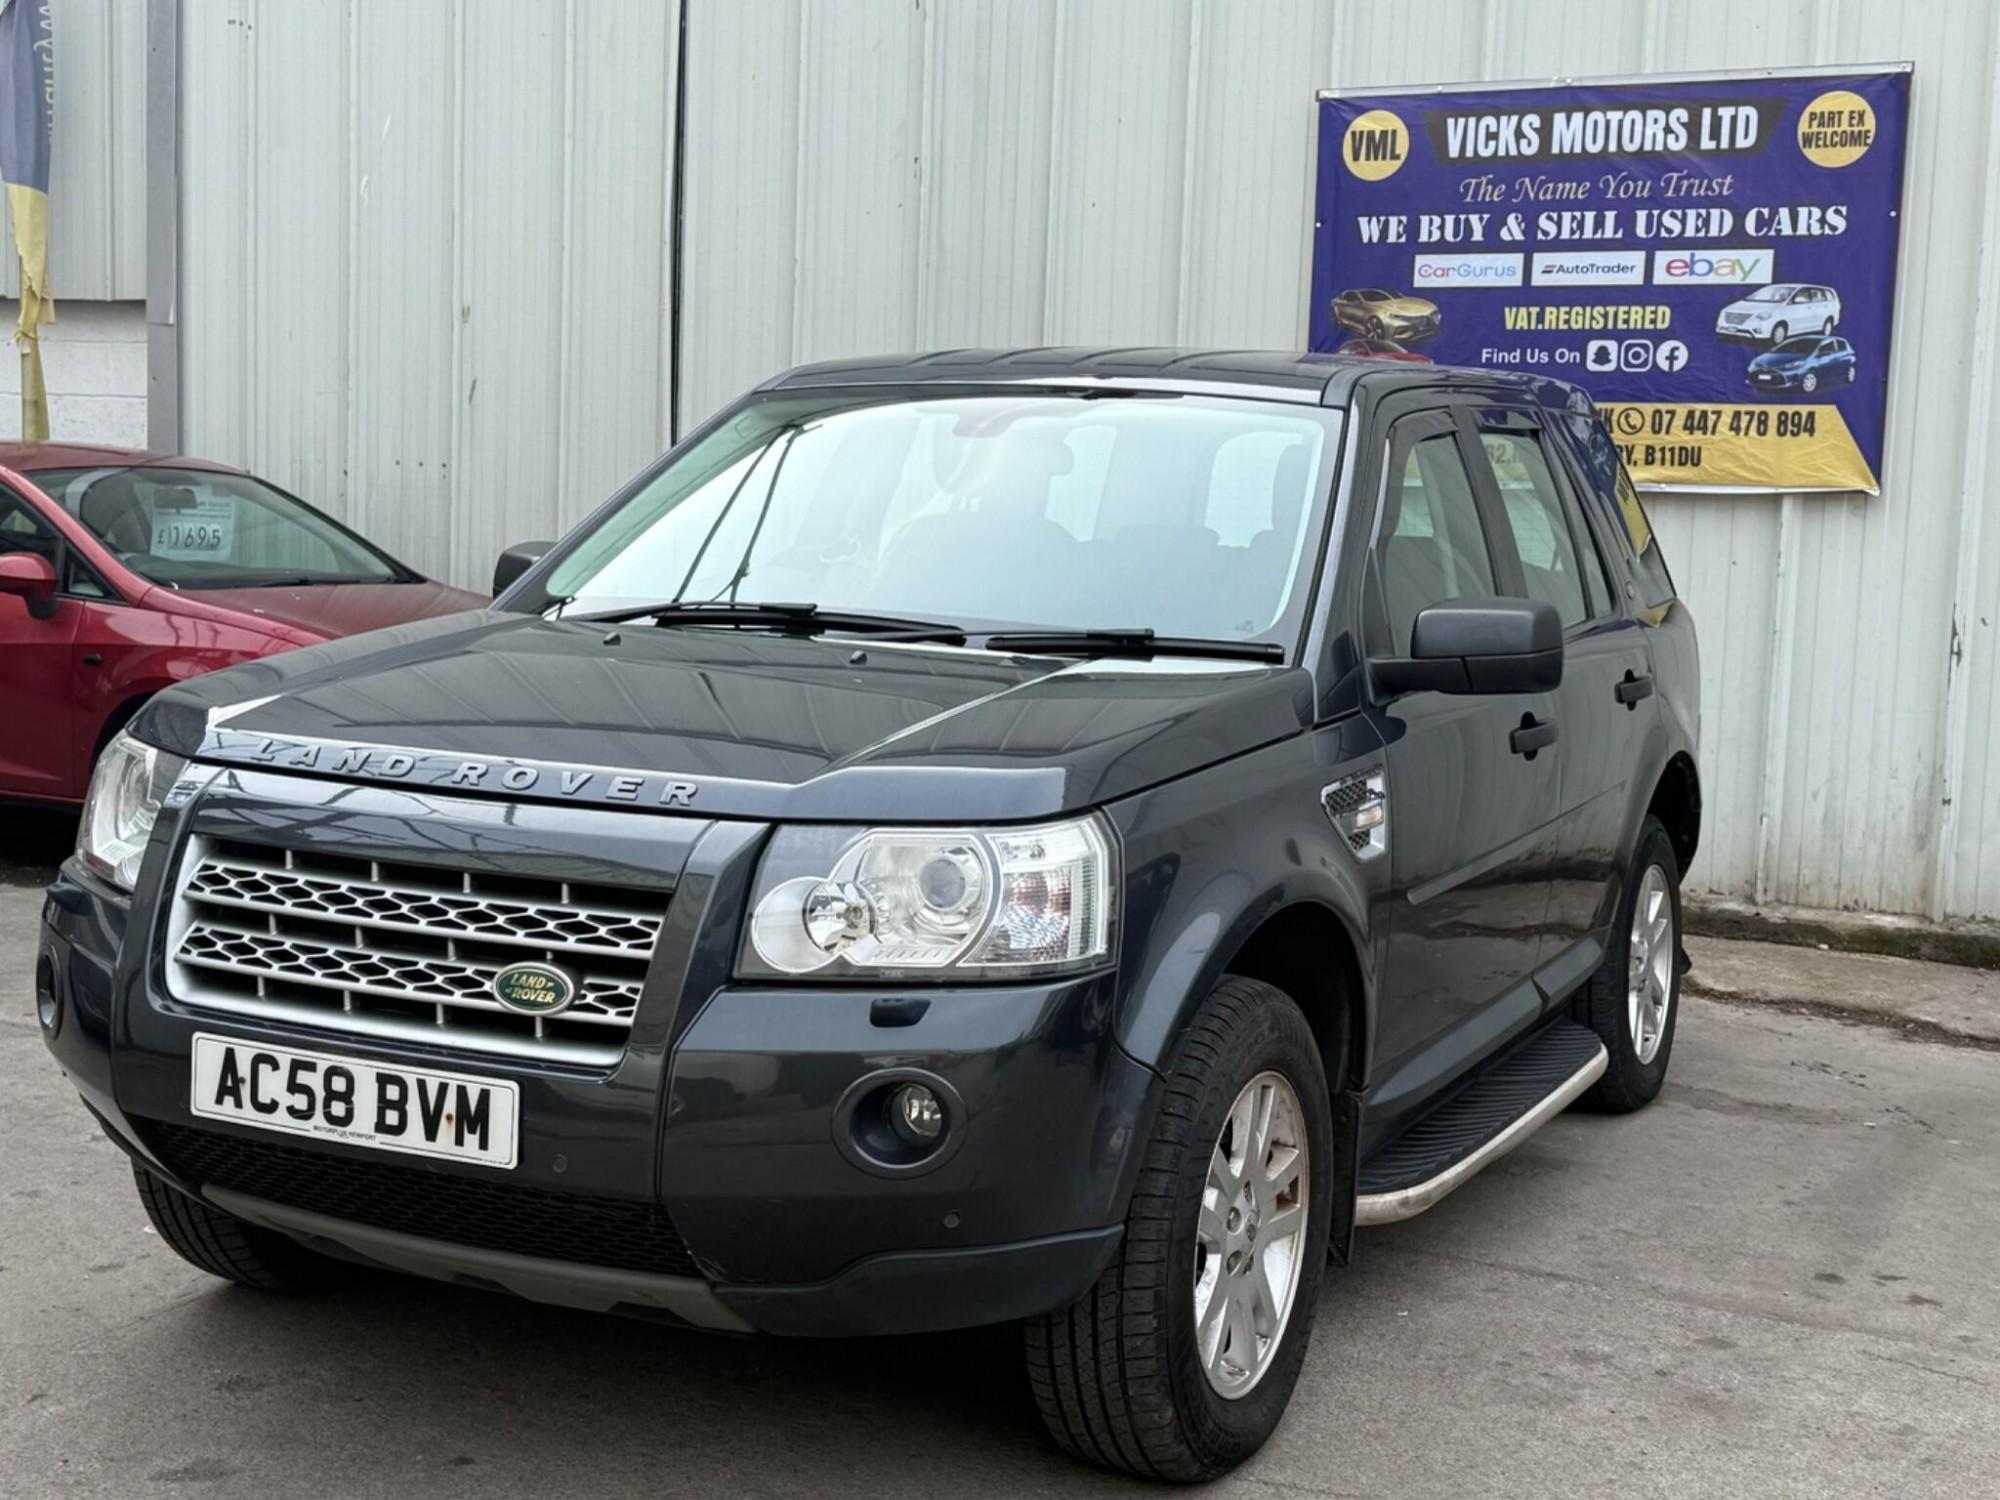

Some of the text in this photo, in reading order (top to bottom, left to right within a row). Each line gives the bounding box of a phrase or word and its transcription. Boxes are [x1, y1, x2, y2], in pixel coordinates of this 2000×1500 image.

[1808, 109, 1866, 129] PART EX
[1446, 105, 1758, 159] VICKS MOTORS LTD
[1802, 129, 1871, 149] WELCOME
[1351, 129, 1401, 162] VML
[1460, 169, 1734, 203] The Name You Trust
[1357, 205, 1848, 244] WE BUY & SELL USED CARS
[1417, 262, 1518, 279] CarGurus
[1555, 261, 1637, 275] AutoTrader
[1665, 252, 1761, 282] ebay
[1504, 305, 1671, 330] VAT.REGISTERED
[1481, 347, 1581, 364] Find Us On
[1651, 408, 1677, 435] 07
[1683, 410, 1722, 436] 447
[1728, 410, 1769, 437] 478
[1776, 410, 1816, 437] 894
[1644, 445, 1702, 468] B11DU
[250, 739, 700, 807] LAND ROVER
[510, 973, 546, 989] LAND
[511, 986, 556, 1003] ROVER
[214, 1046, 492, 1151] AC58 BVM
